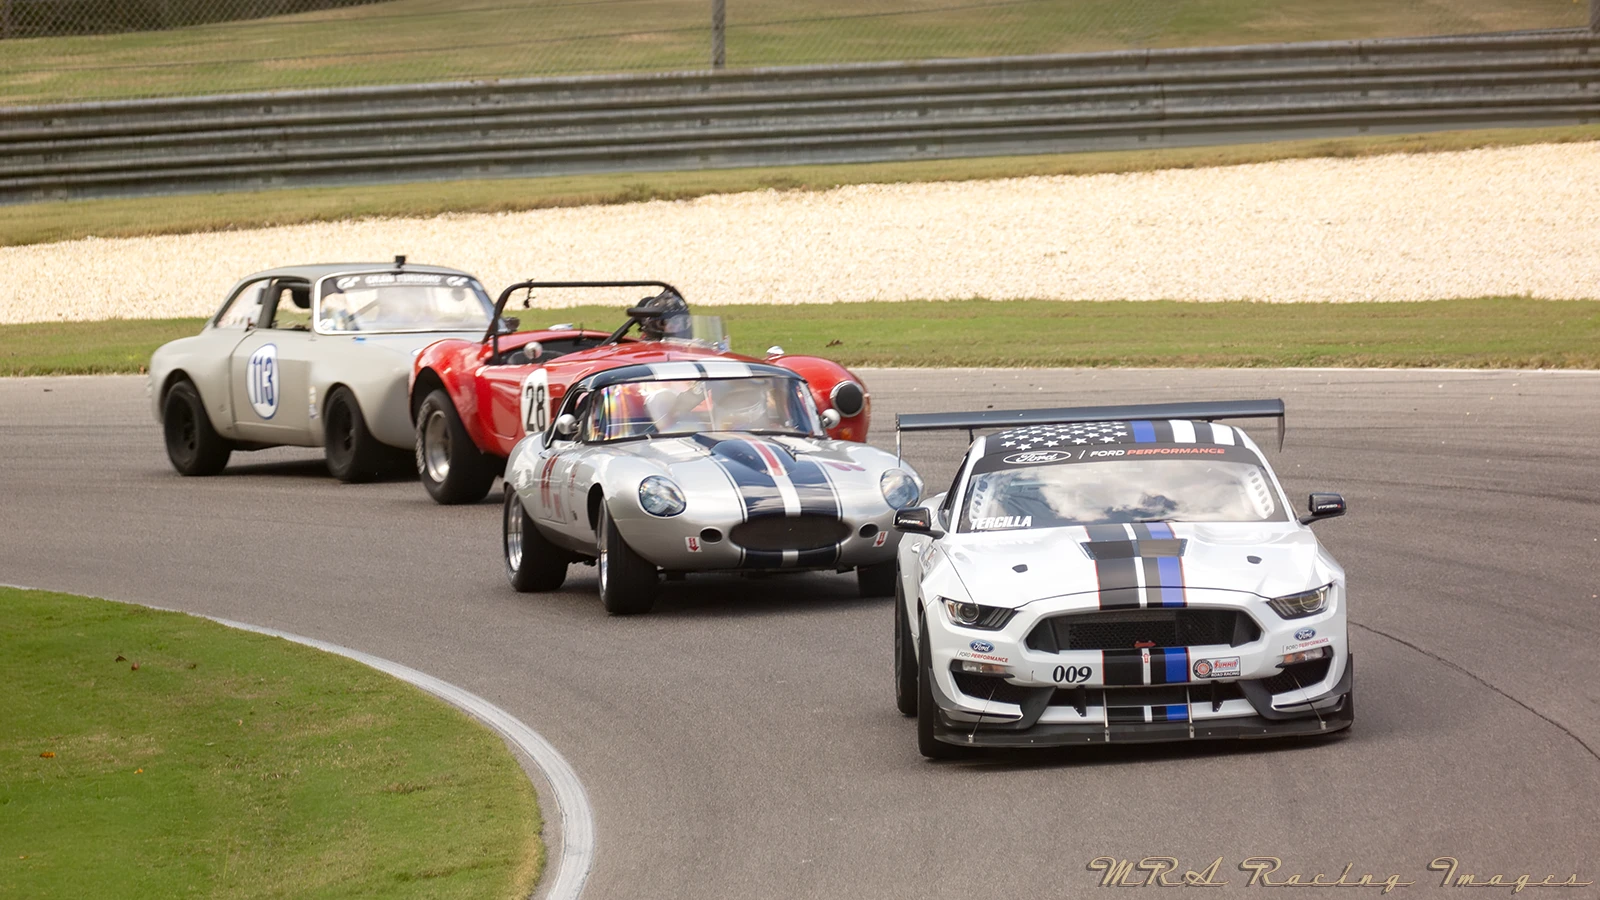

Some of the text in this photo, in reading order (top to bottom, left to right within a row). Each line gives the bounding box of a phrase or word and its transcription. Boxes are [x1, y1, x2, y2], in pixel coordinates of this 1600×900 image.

[253, 355, 274, 406] 113
[526, 382, 546, 432] 28
[1090, 447, 1225, 458] FORD PERFORMANCE
[970, 515, 1033, 531] TERCILLA
[1298, 637, 1329, 649] PERFORMANCE
[971, 653, 1009, 663] PERFORMANCE
[1053, 665, 1093, 683] 009
